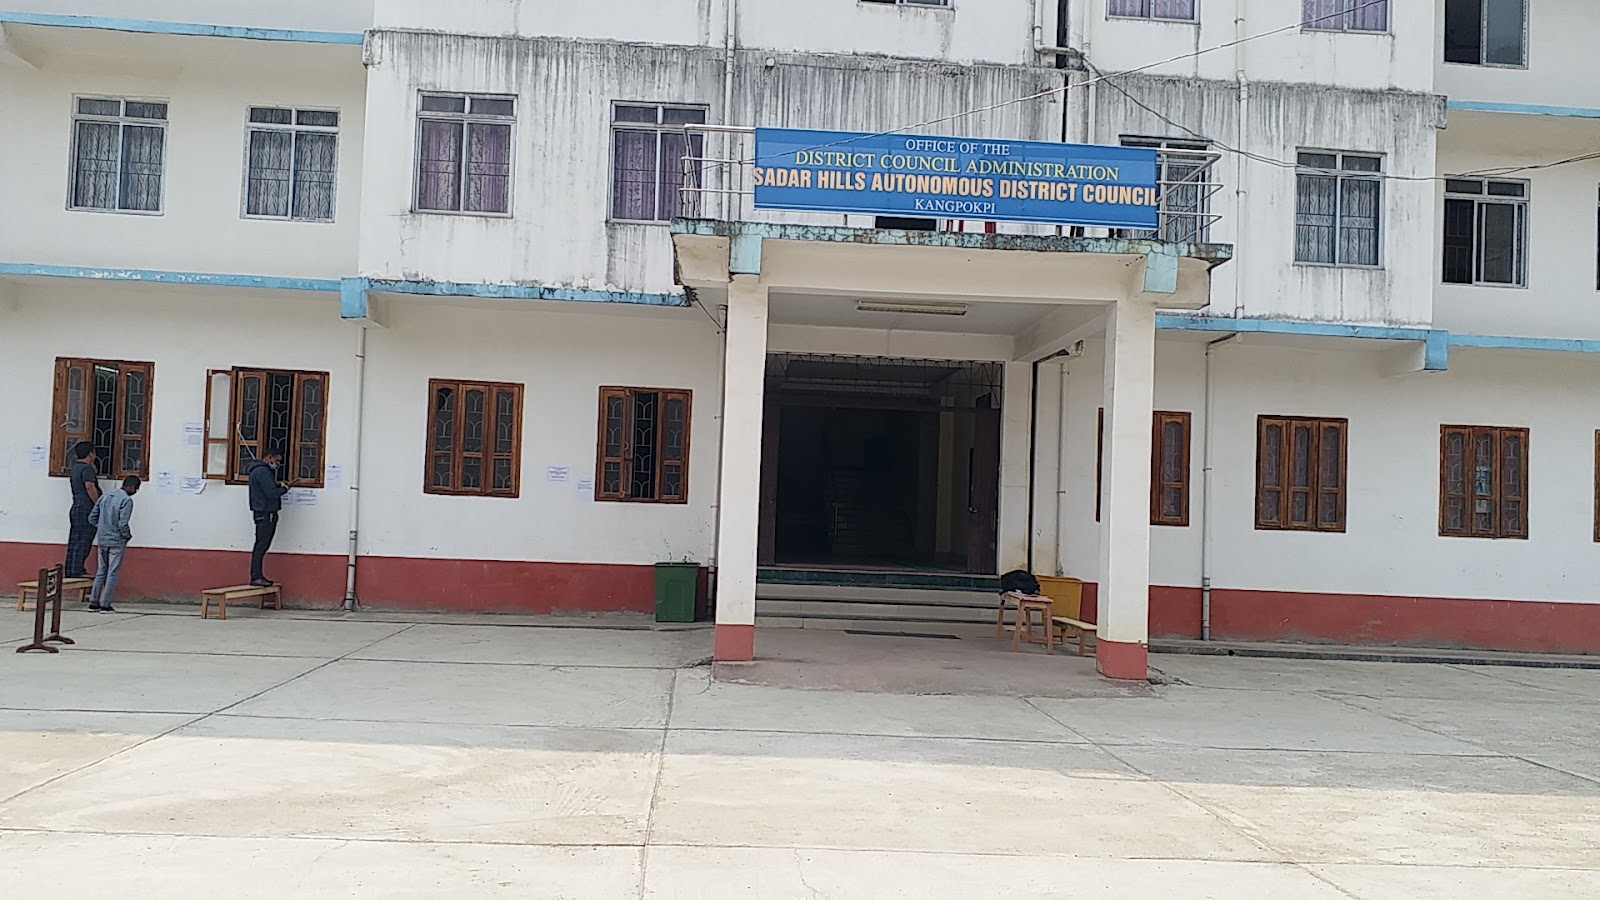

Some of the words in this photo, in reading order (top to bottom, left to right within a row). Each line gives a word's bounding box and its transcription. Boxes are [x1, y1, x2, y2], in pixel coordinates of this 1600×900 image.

[905, 138, 955, 153] OFFICE
[959, 142, 978, 154] OF
[982, 143, 1010, 156] THE
[795, 151, 875, 168] DISTRICT
[880, 154, 961, 173] COUNCIL
[966, 159, 1120, 181] ADMINISTRATION
[754, 167, 812, 188] SADAR
[817, 170, 866, 191] HILLS
[871, 172, 993, 198] AUTONOMOUS
[999, 179, 1078, 201] DISTRICT
[1082, 184, 1158, 207] COUNCIL
[914, 198, 996, 214] KANGPOKPI
